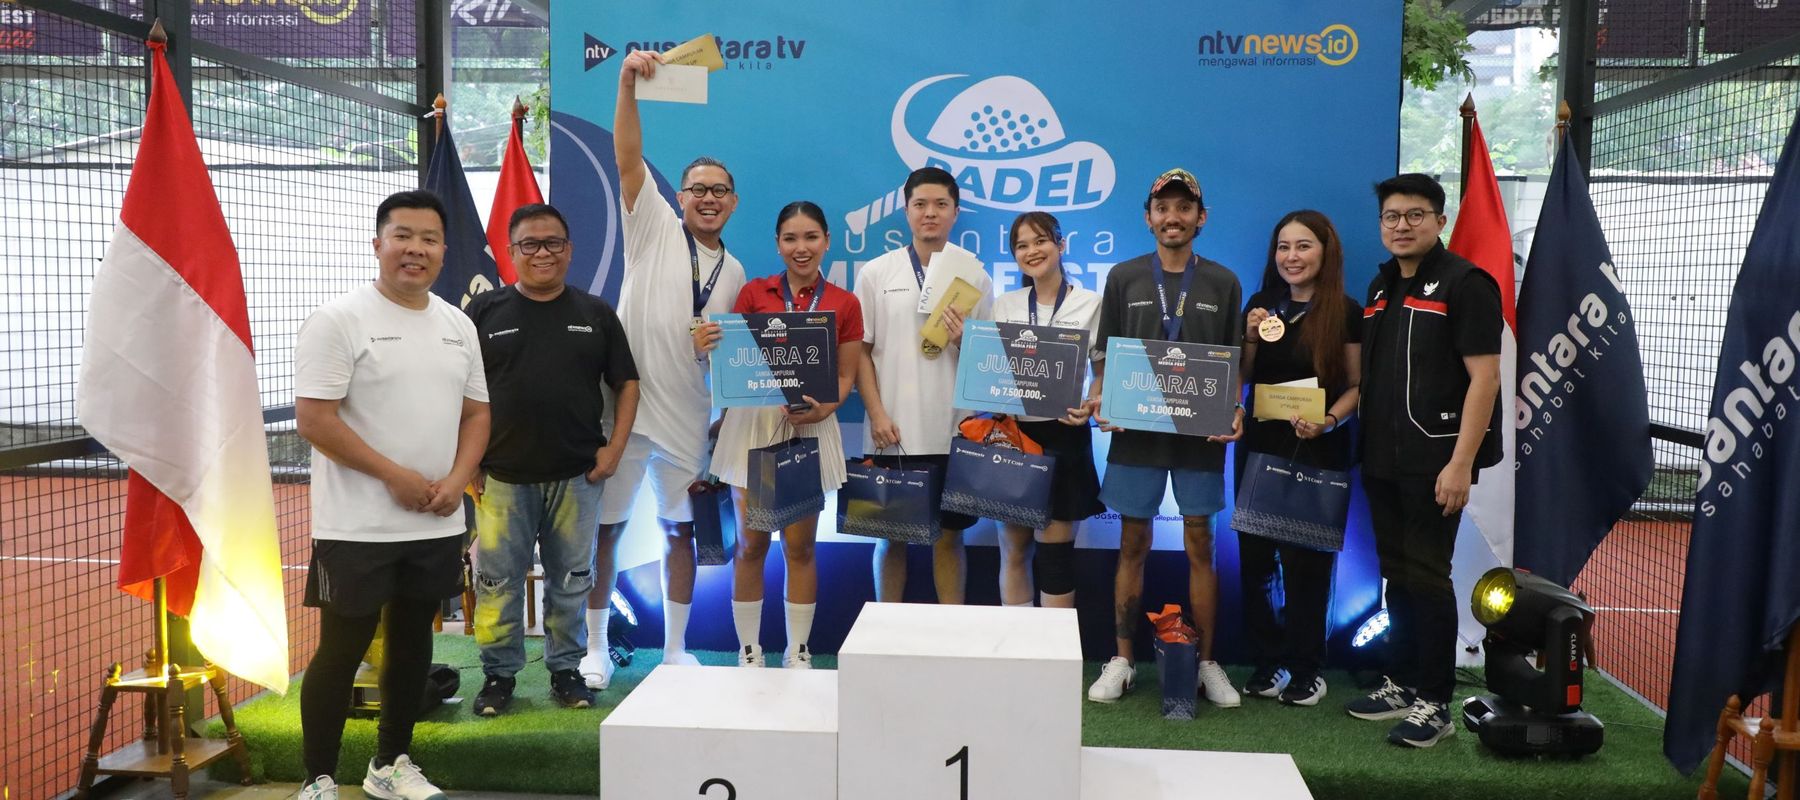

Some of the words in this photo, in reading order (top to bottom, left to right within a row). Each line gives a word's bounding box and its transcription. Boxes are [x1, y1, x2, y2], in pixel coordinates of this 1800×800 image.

[585, 44, 610, 59] ntv
[625, 36, 771, 60] nustara
[776, 36, 806, 60] tv
[1198, 30, 1347, 55] ntvnews.id
[1198, 57, 1257, 68] mengawal
[1262, 56, 1316, 66] informasi
[1588, 311, 1627, 361] kita
[729, 346, 802, 368] JUARA
[806, 345, 820, 365] 2
[977, 354, 1050, 378] JUARA
[1055, 361, 1064, 380] 1
[748, 380, 758, 391] Rp
[760, 378, 805, 389] 5.000.000,-
[990, 385, 1000, 397] Rp
[1002, 387, 1046, 401] 7.500.000,-
[1121, 371, 1199, 396] JUARA
[1203, 378, 1218, 397] 3
[1137, 403, 1149, 415] Rp
[1150, 404, 1197, 418] 3.000.000,-
[945, 746, 969, 800] 1
